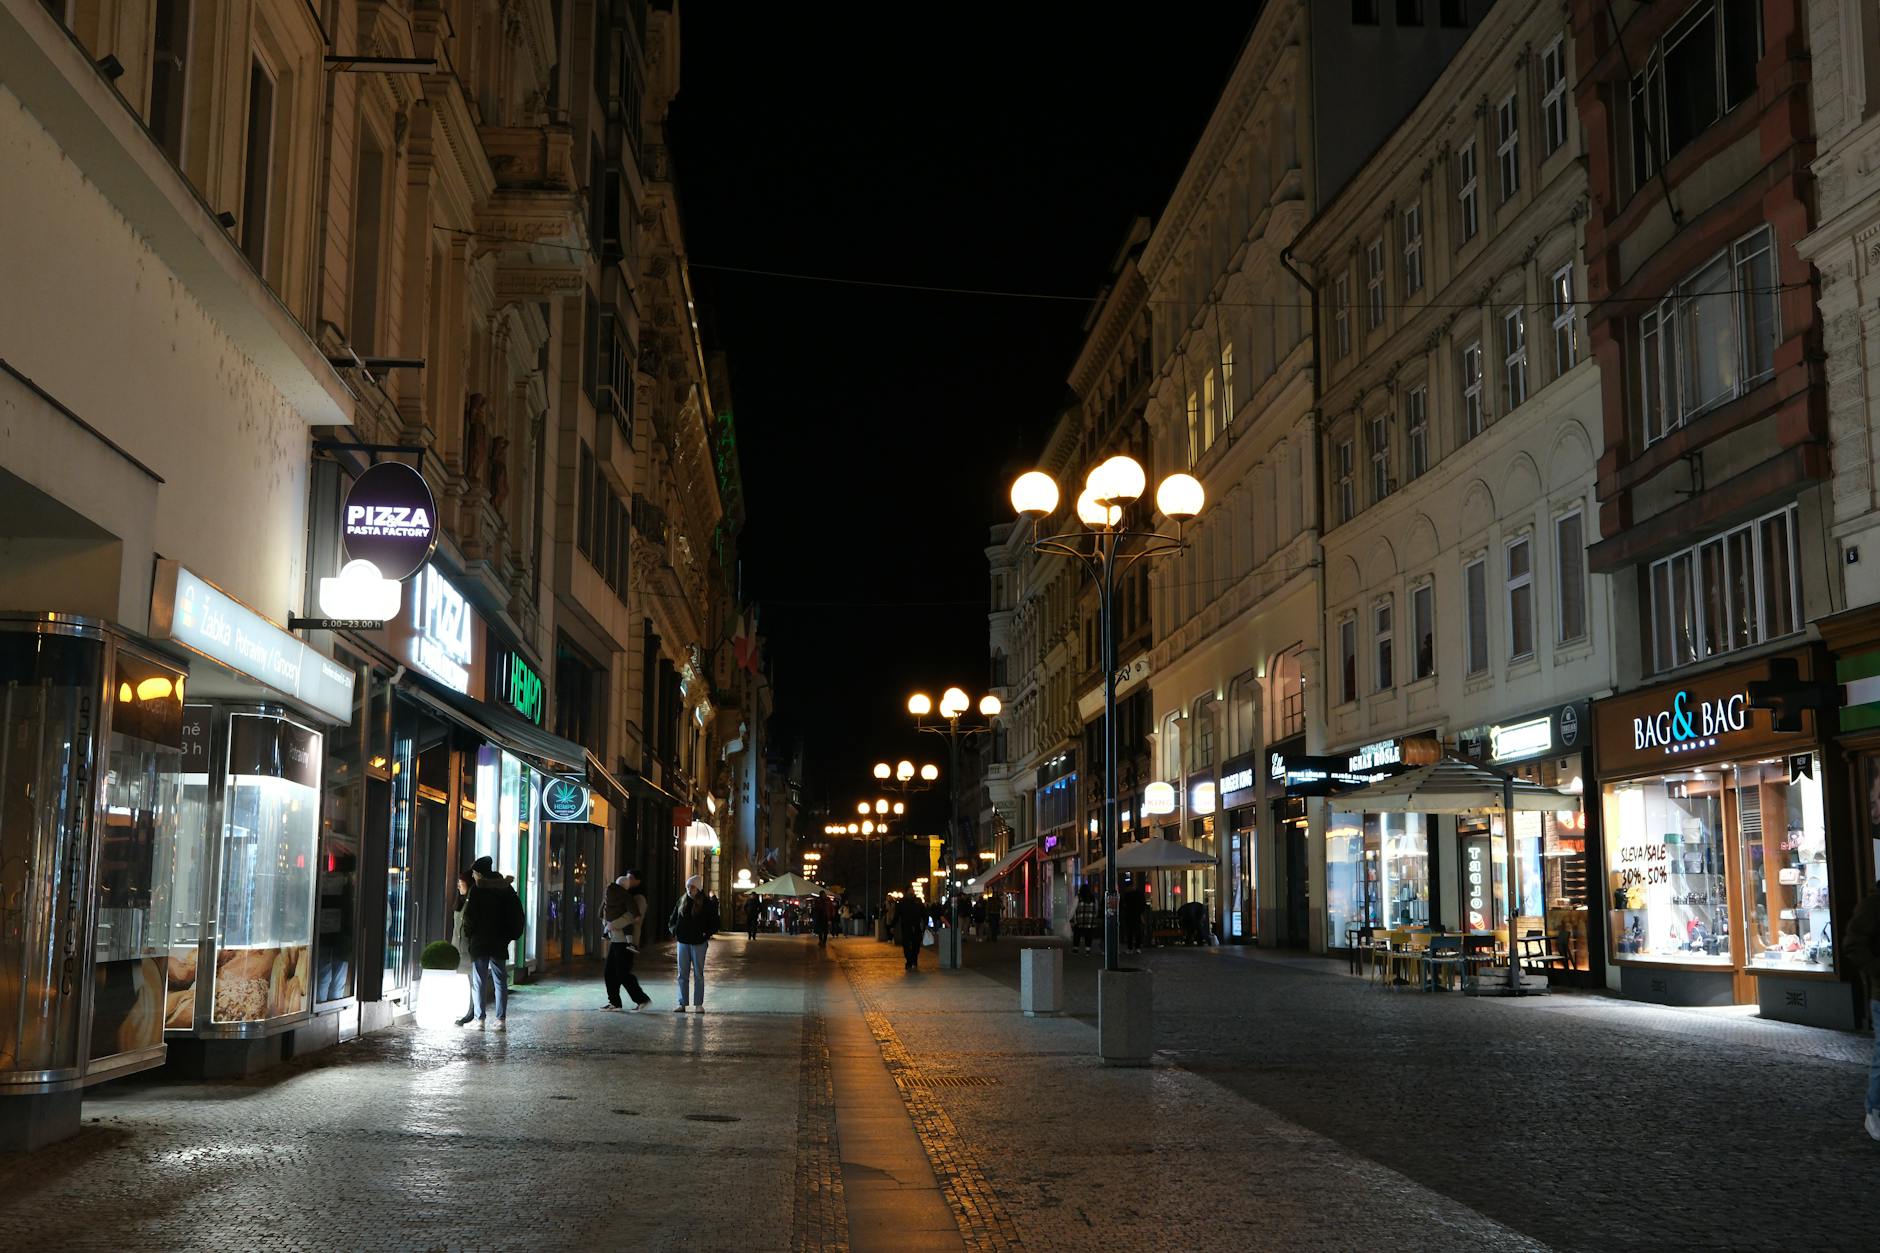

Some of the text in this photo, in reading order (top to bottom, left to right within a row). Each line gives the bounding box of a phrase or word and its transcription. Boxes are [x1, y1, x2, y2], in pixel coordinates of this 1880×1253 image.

[346, 526, 430, 537] PASTA FACTORY
[347, 505, 431, 528] PIZZA
[199, 596, 232, 647] Žabka
[235, 627, 268, 672] Potraviny
[273, 650, 300, 688] Grocery
[510, 651, 542, 726] HEMPO
[75, 695, 91, 757] Club
[1633, 691, 1746, 750] BAG & BAG
[1373, 746, 1401, 767] RÖSLE
[1664, 738, 1716, 754] LONDON
[742, 768, 750, 804] INN
[1220, 768, 1253, 795] BURGER KING
